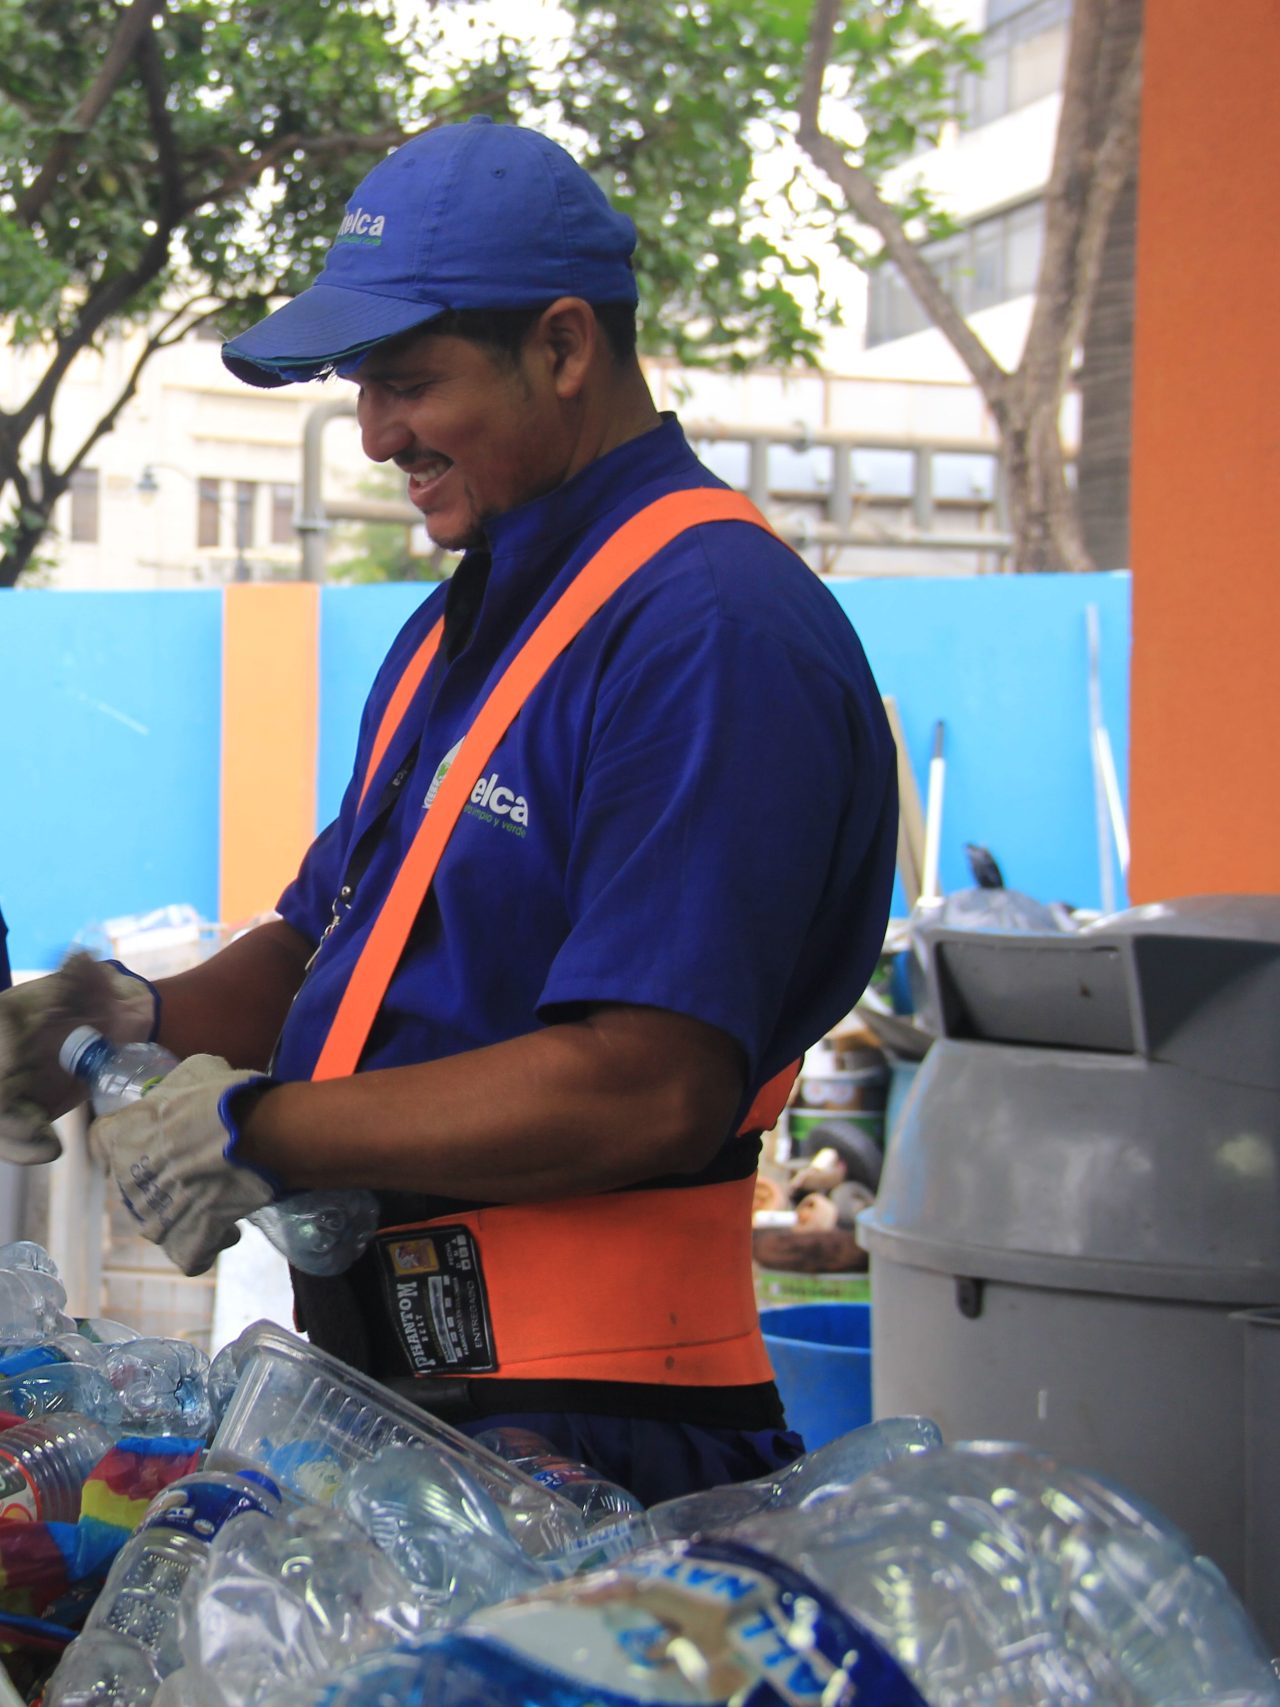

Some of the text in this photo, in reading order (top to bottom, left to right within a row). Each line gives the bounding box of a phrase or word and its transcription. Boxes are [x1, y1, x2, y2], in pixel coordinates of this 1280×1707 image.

[470, 773, 529, 827] elca
[396, 1280, 437, 1368] PHANTOM
[415, 1314, 429, 1342] BELT
[466, 1280, 484, 1349] ENTREGADO
